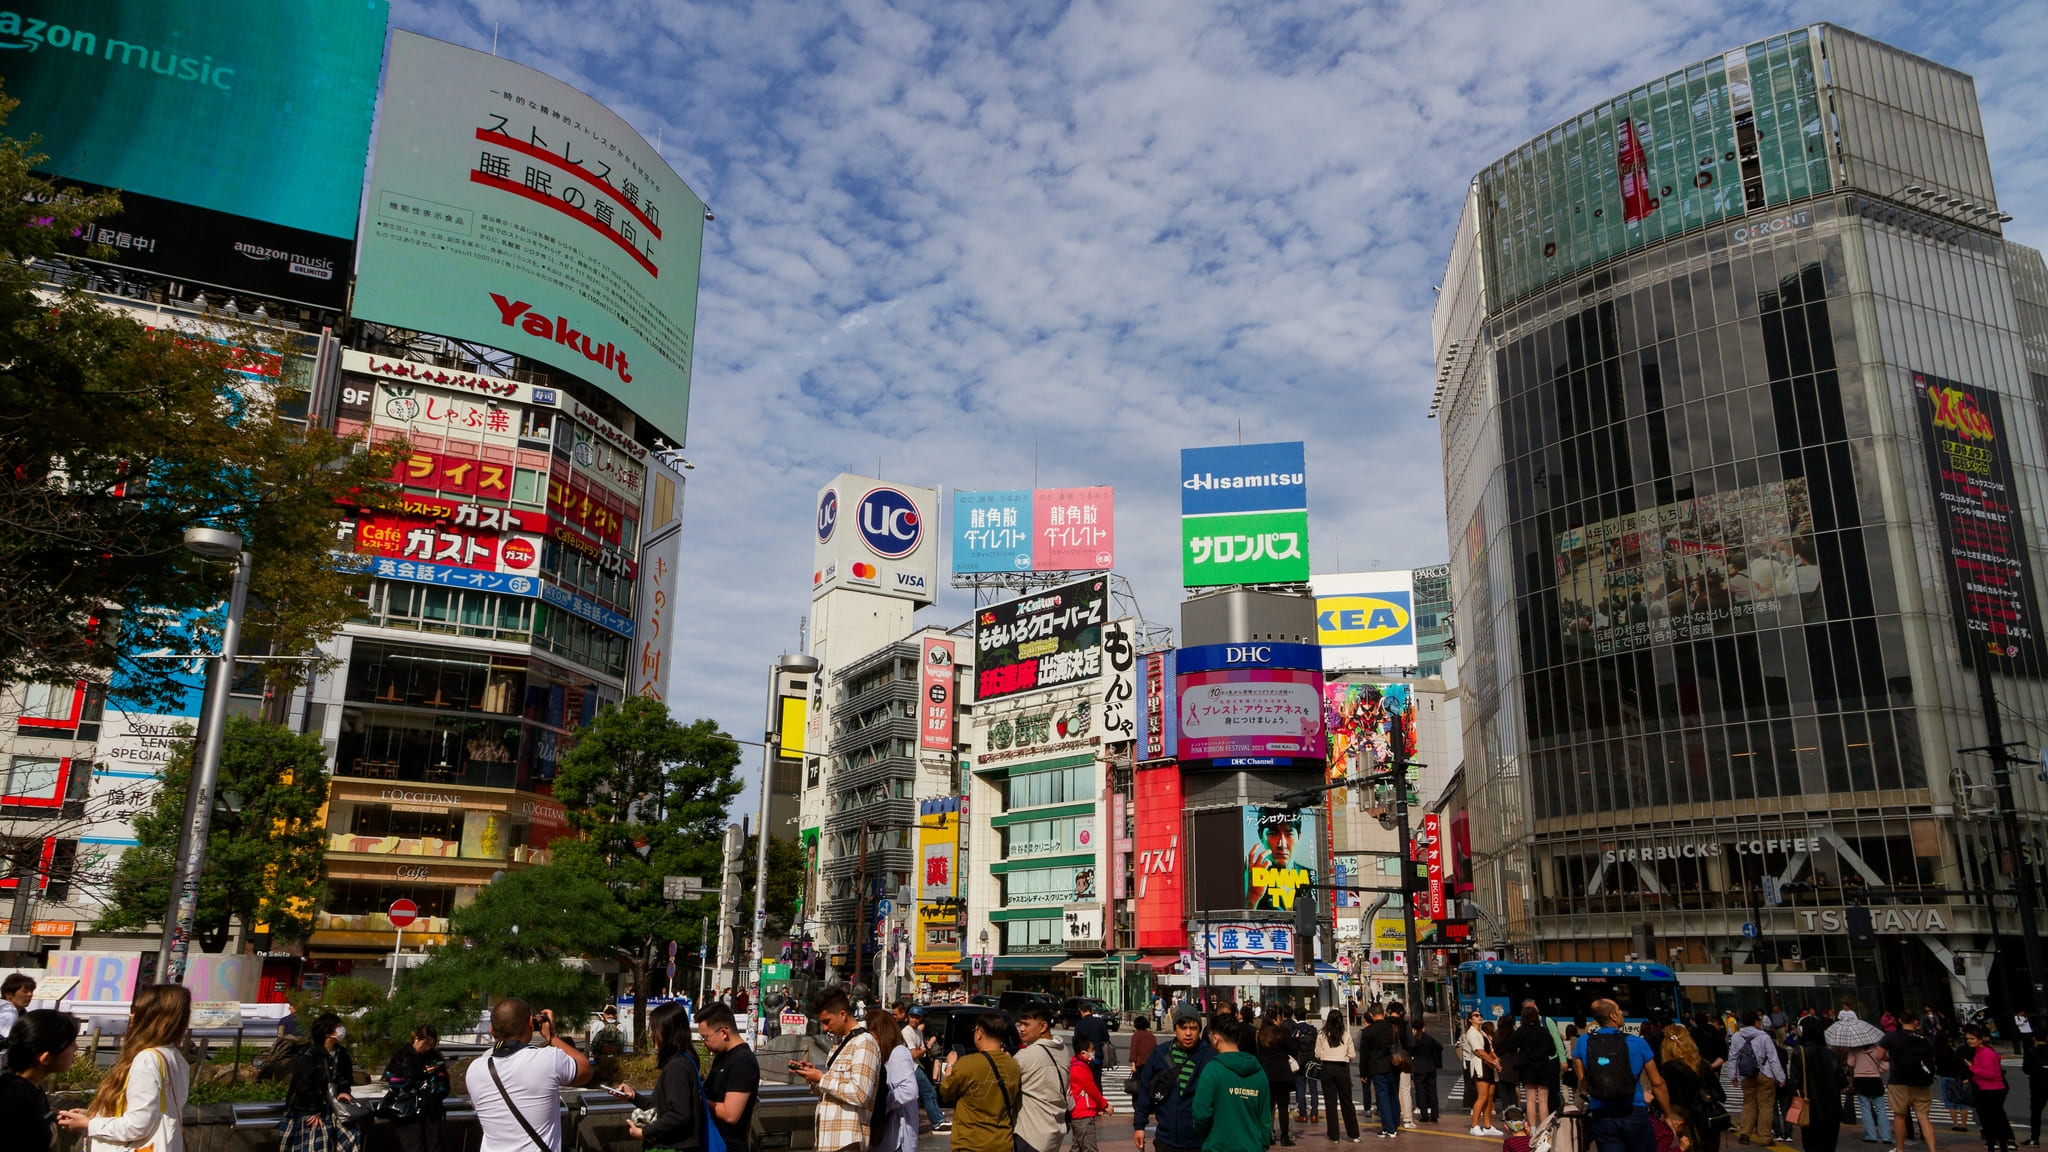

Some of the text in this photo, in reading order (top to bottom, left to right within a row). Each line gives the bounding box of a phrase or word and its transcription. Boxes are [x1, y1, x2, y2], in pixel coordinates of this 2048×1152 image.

[105, 38, 235, 90] music
[484, 113, 660, 229] ストレス緩和
[479, 151, 656, 268] 睡眠の質向上
[234, 240, 335, 270] amazon music
[489, 292, 633, 384] Yakult
[369, 356, 518, 396] しゃぶしゃぶバイキング
[343, 388, 370, 406] 9F
[426, 397, 510, 432] しゃぶ葉
[597, 448, 639, 491] しゃぶ葉
[1183, 473, 1303, 490] Hisamitsu
[455, 503, 521, 531] ガスト
[547, 478, 619, 534] コンタクト
[820, 500, 837, 529] UC
[971, 507, 1017, 528] 龍角散
[1051, 504, 1097, 525] 龍角散
[863, 502, 916, 541] UC
[363, 525, 400, 544] Café
[363, 540, 399, 551] レストラン
[403, 528, 490, 565] ガスト
[964, 529, 1025, 550] ダイレクト
[1044, 526, 1106, 547] ダイレクト
[505, 550, 532, 562] ガスト
[1190, 532, 1301, 564] サロンパス
[600, 547, 632, 578] ガスト
[826, 563, 836, 577] VISA
[1414, 565, 1449, 580] PARCO
[512, 579, 527, 591] 6F
[896, 573, 924, 587] VISA
[545, 585, 569, 603] AEON
[572, 597, 633, 634] 英会話イーオン
[979, 599, 1102, 652] ももいろクローバーZ
[1317, 608, 1401, 632] KEA
[1226, 646, 1271, 663] DHC
[1104, 622, 1134, 738] もんじゃ
[1147, 655, 1162, 754] 三千里薬品
[1202, 704, 1310, 717] ブレスト・アウェアネスを
[1225, 716, 1288, 726] 身につけましょう。
[1426, 821, 1440, 874] カラオケ
[1605, 837, 1821, 864] STARBUCKS COFFEE
[396, 864, 429, 880] Café
[926, 856, 948, 886] 薬
[1139, 834, 1178, 899] クスリ
[1252, 867, 1310, 888] DMM
[1268, 887, 1297, 908] TV
[31, 923, 70, 933] 銀行 8F
[1801, 908, 1947, 931] TSTAYA
[1202, 928, 1289, 950] 大盛堂書
